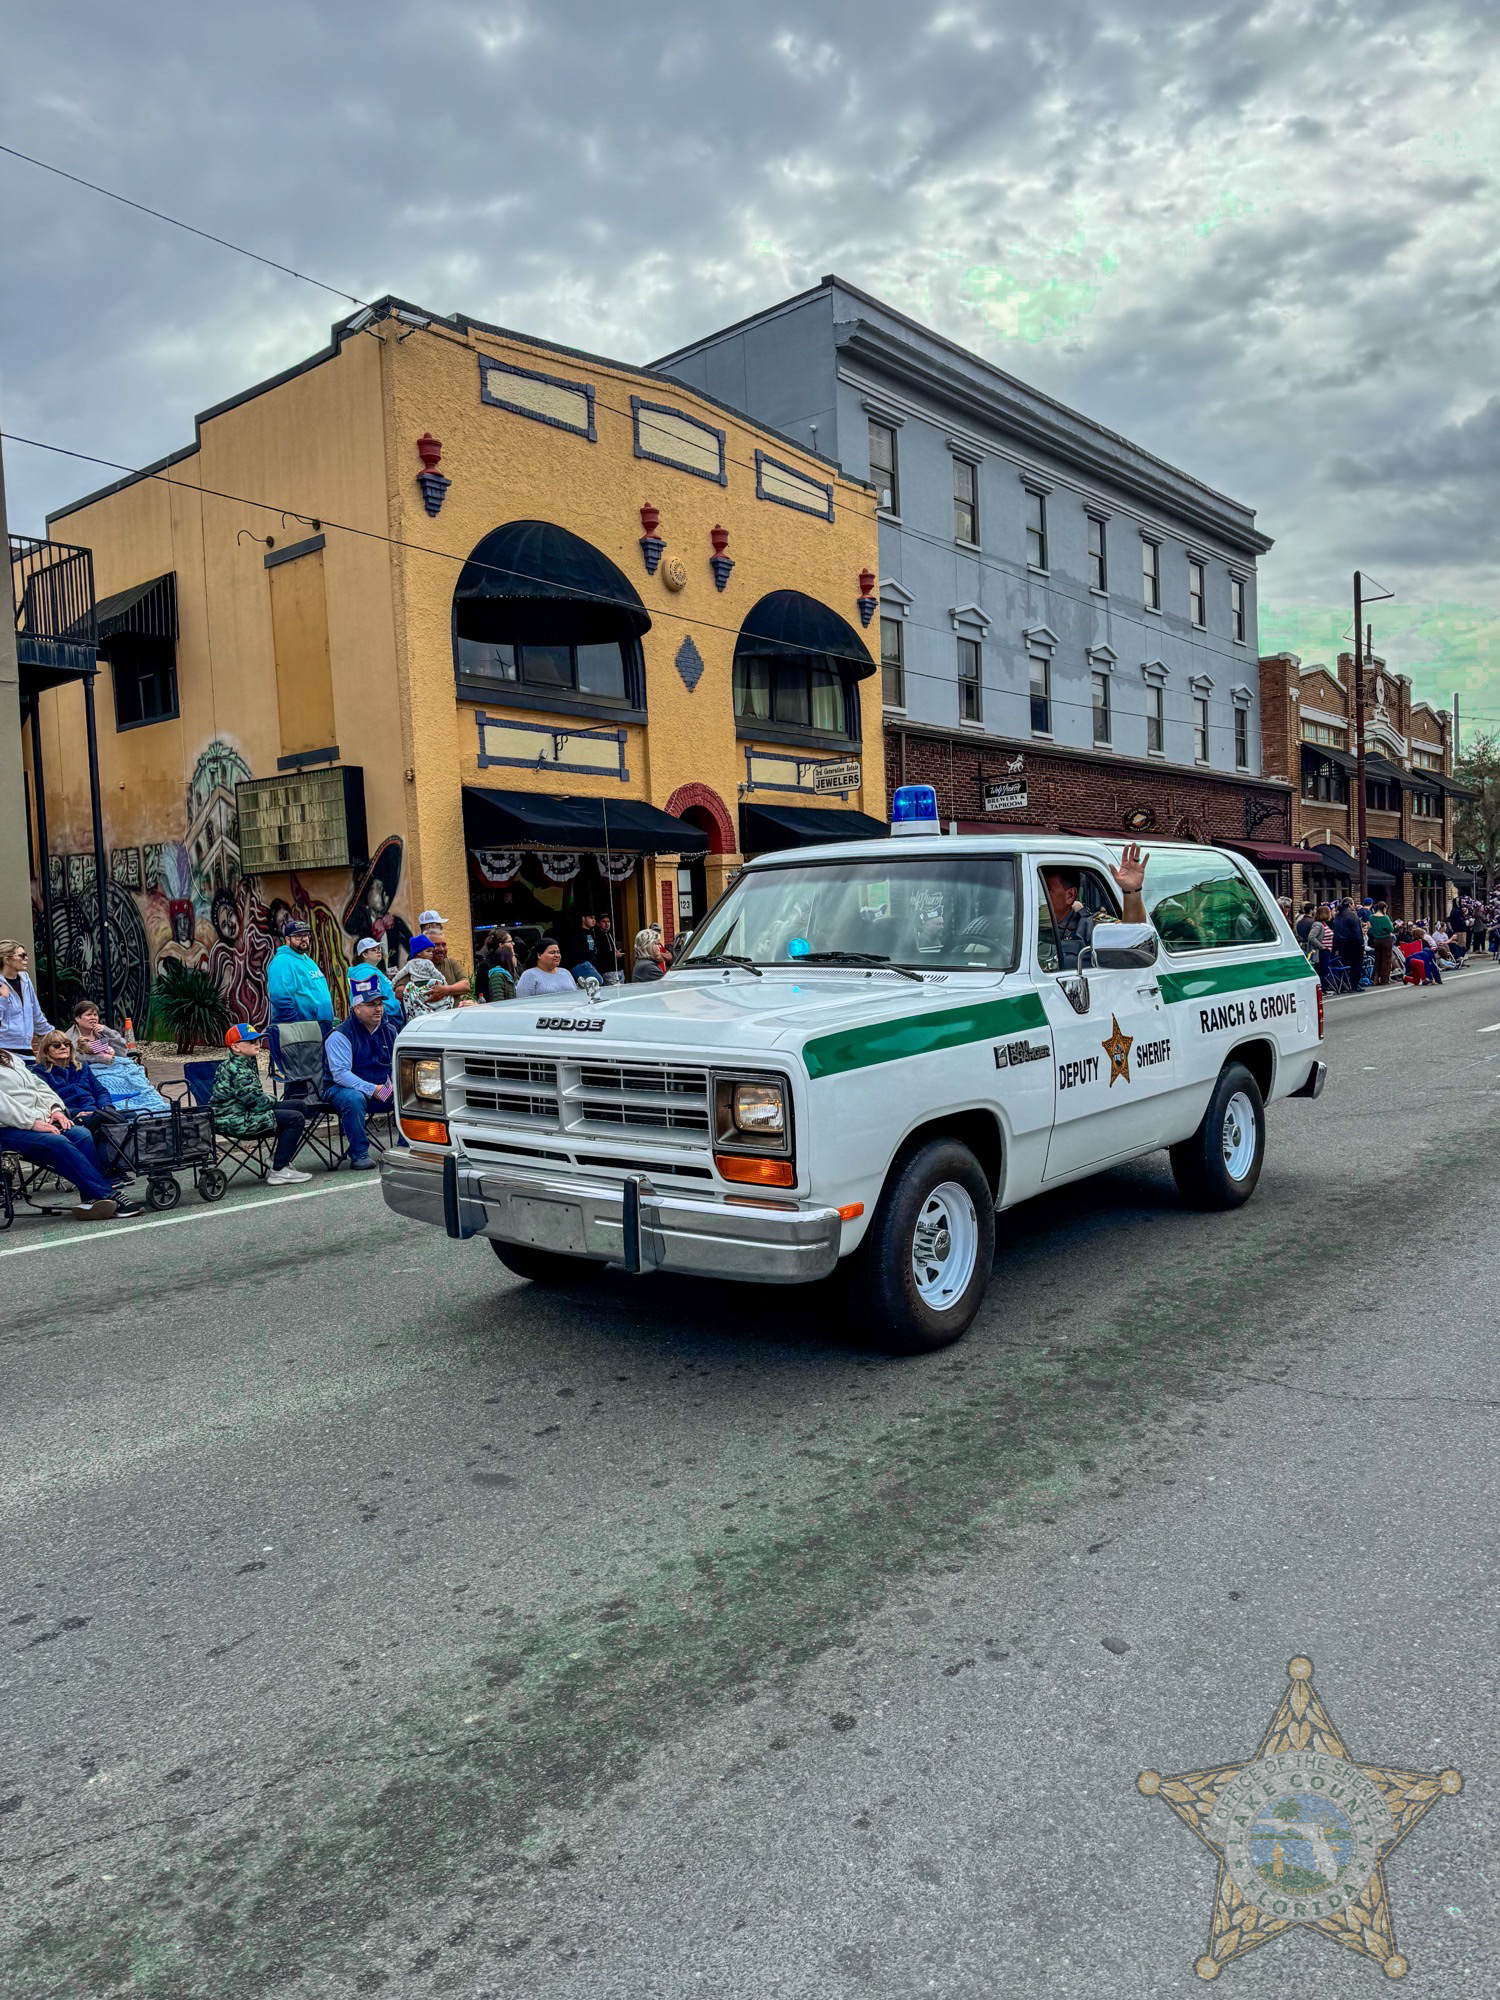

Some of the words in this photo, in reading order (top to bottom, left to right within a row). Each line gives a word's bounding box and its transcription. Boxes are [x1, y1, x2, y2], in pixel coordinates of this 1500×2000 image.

[824, 766, 845, 775] Generation
[816, 774, 860, 789] JEWELERS
[987, 795, 1019, 804] BREWERY
[990, 801, 1023, 810] TAPROOM
[680, 900, 691, 910] 123
[1200, 1005, 1246, 1033] RANCH
[1249, 1001, 1258, 1022] &
[1260, 992, 1297, 1020] GROVE
[536, 1016, 606, 1032] DODGE
[1059, 1056, 1099, 1090] DEPUTY
[1136, 1038, 1171, 1068] SHERIFF
